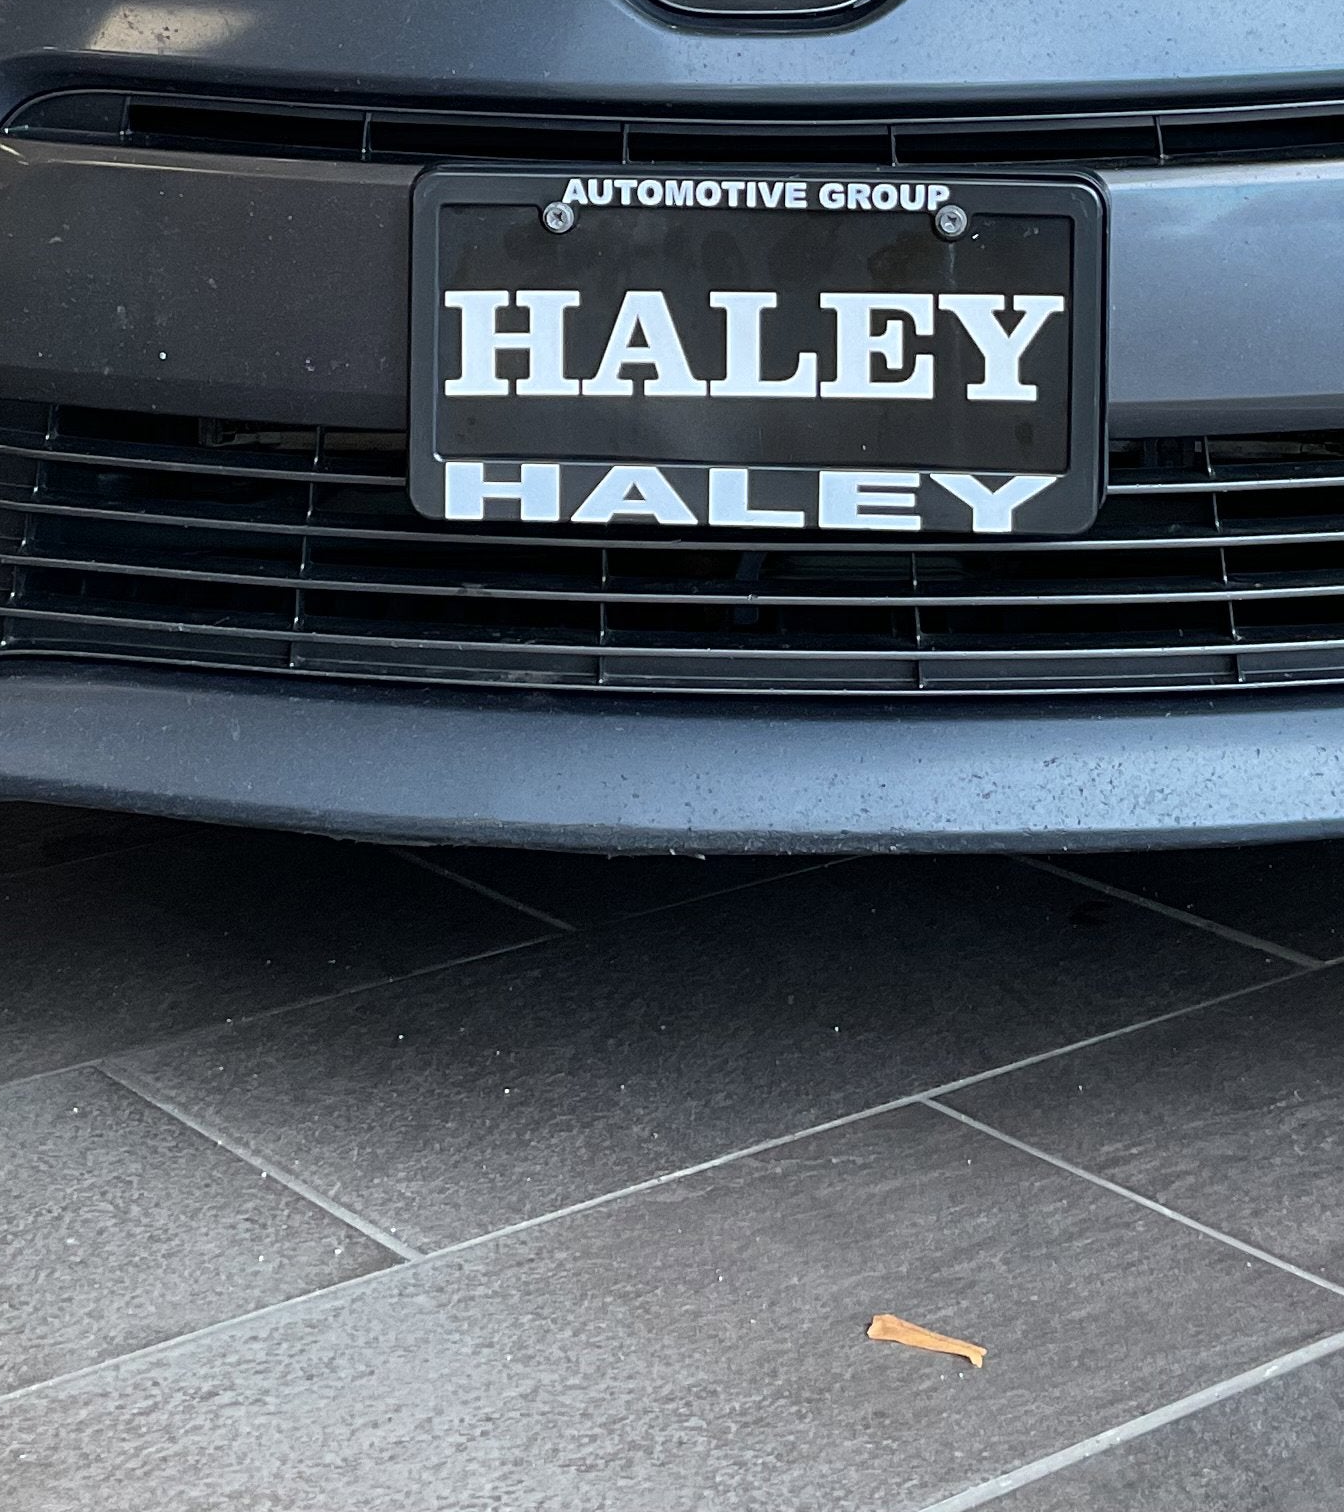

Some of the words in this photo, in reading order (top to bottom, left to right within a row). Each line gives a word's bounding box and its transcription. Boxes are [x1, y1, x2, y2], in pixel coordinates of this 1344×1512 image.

[562, 178, 808, 209] AUTOMOTIVE
[819, 181, 950, 211] GROUP
[444, 290, 1065, 401] HALEY
[444, 462, 1058, 533] HALEY
